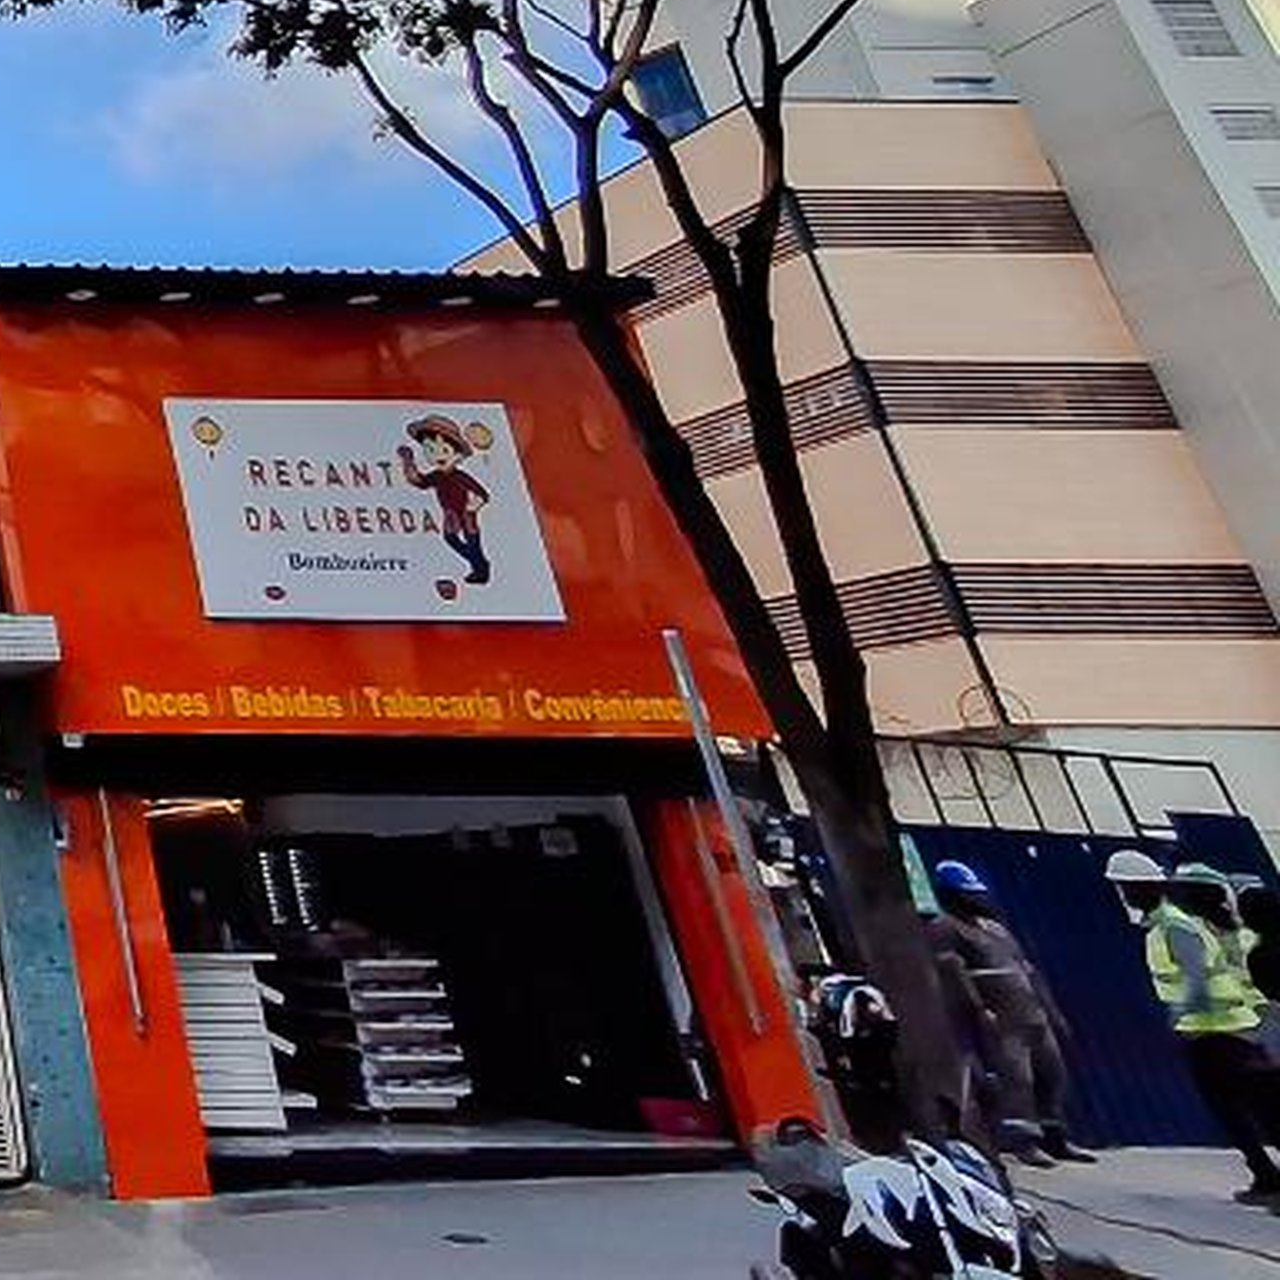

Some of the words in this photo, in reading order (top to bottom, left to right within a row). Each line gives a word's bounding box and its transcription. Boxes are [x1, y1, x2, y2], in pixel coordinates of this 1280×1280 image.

[247, 459, 393, 487] RECANT
[243, 507, 287, 532] DA
[302, 506, 440, 533] LIBERDA
[121, 685, 210, 718] Doces
[230, 685, 343, 719] Bebidas
[362, 686, 503, 719] Tabacaria
